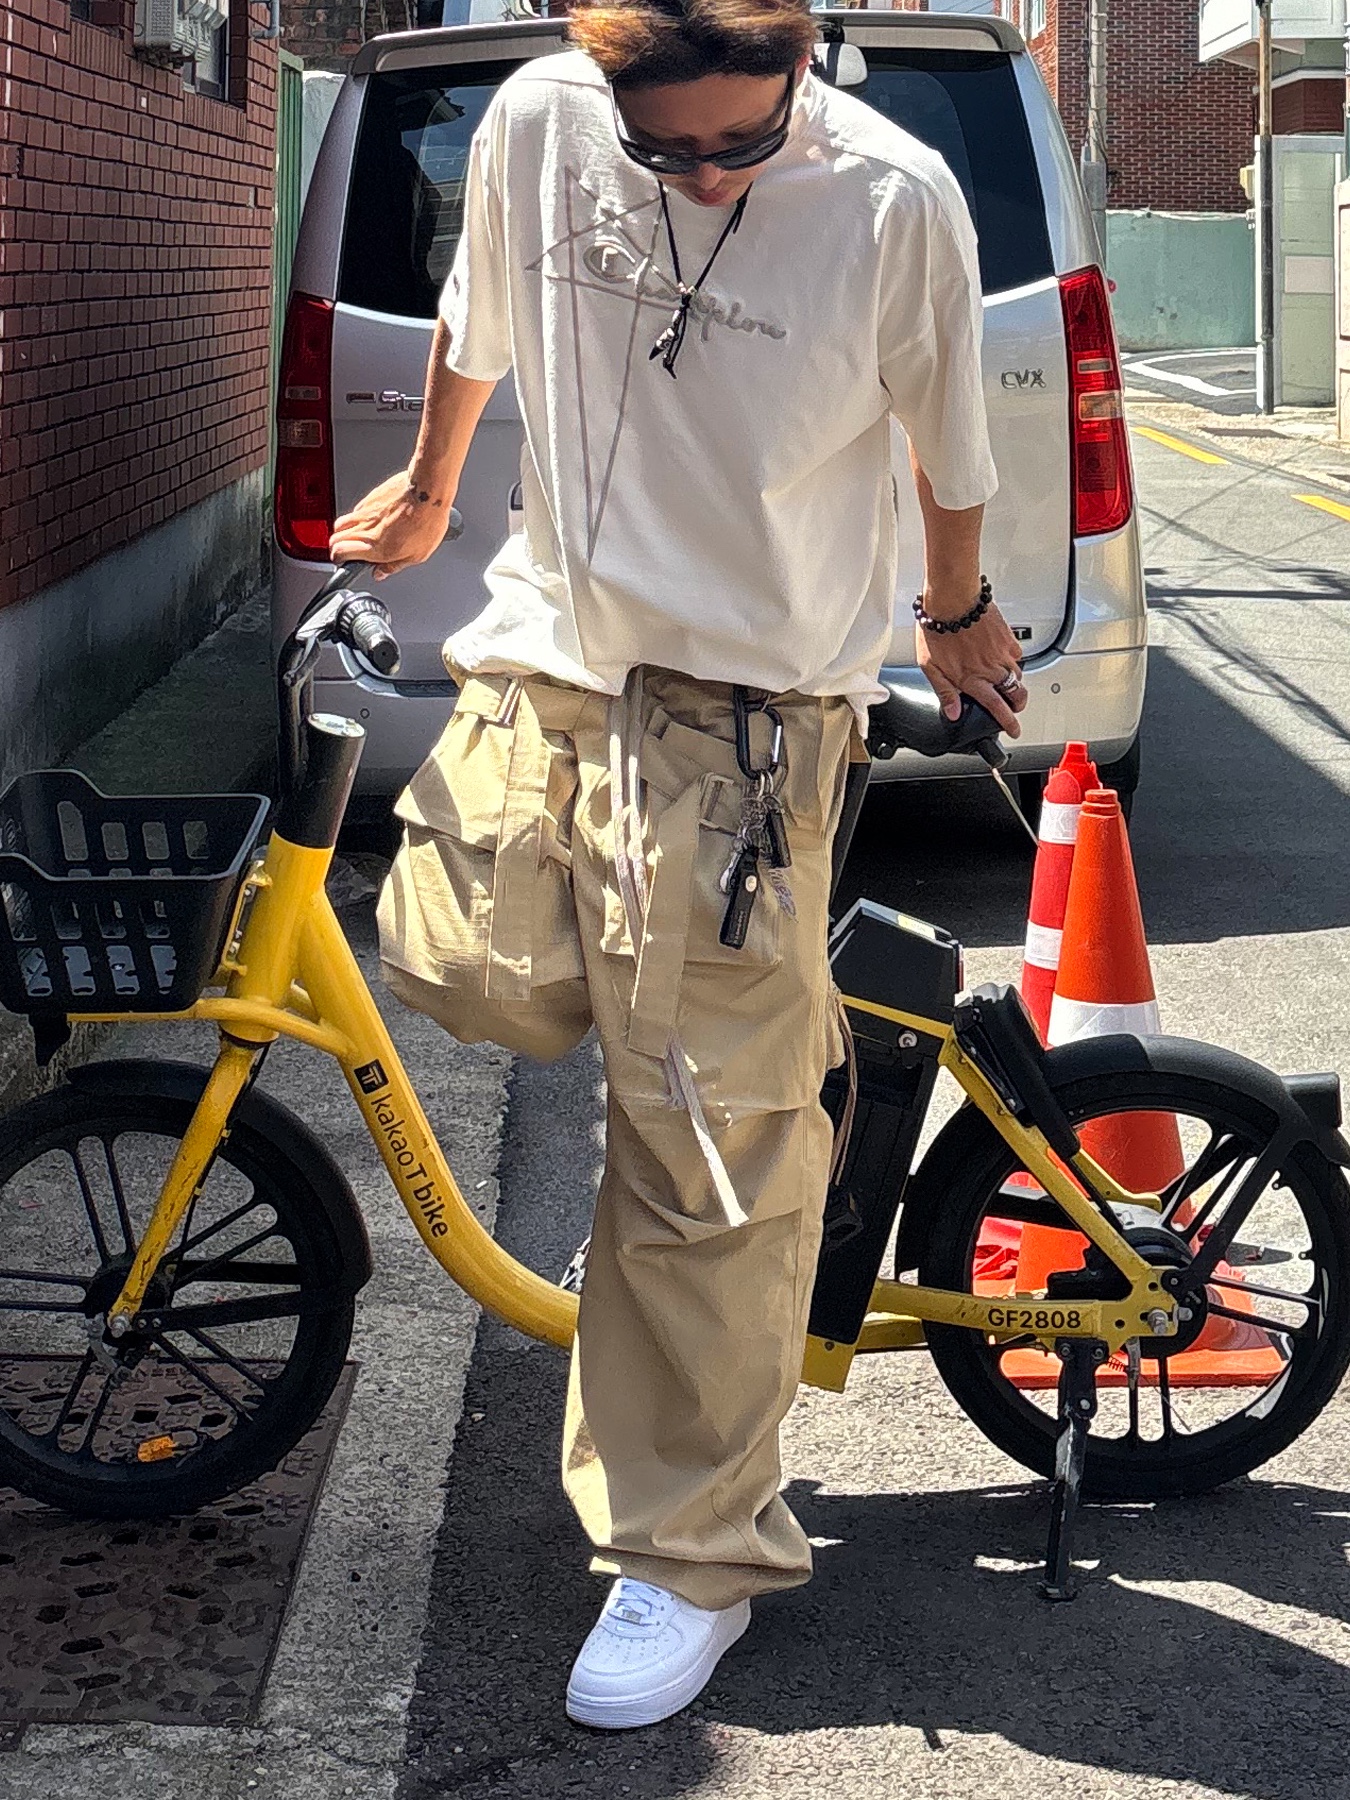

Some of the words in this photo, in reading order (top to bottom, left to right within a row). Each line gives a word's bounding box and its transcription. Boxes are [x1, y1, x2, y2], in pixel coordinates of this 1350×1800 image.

[1001, 368, 1047, 390] CVX
[370, 1093, 415, 1167] kakao
[413, 1181, 449, 1238] bike
[987, 1308, 1081, 1329] GF2808
